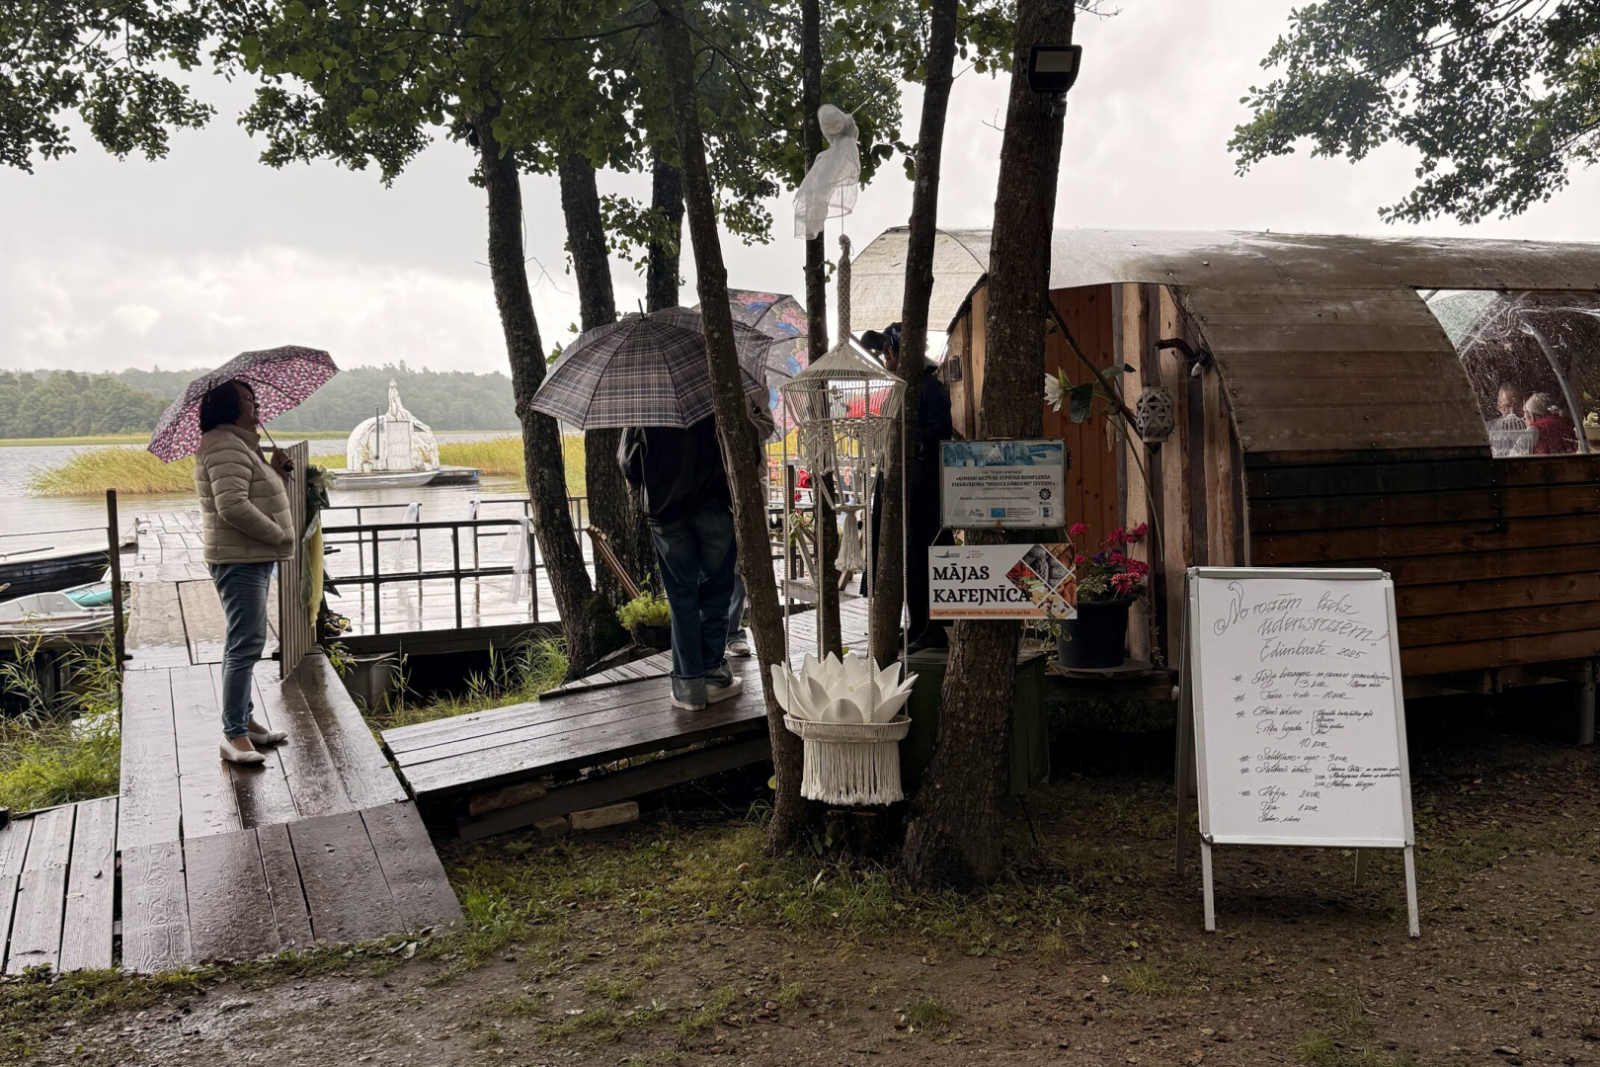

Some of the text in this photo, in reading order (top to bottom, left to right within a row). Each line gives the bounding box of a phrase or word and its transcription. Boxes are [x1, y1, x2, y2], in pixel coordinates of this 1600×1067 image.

[932, 563, 990, 583] MĀJAS
[933, 585, 1031, 606] KAFEJNĪCA
[1337, 648, 1367, 659] 2025
[1300, 680, 1309, 688] 3
[1299, 738, 1330, 748] 10 EUR
